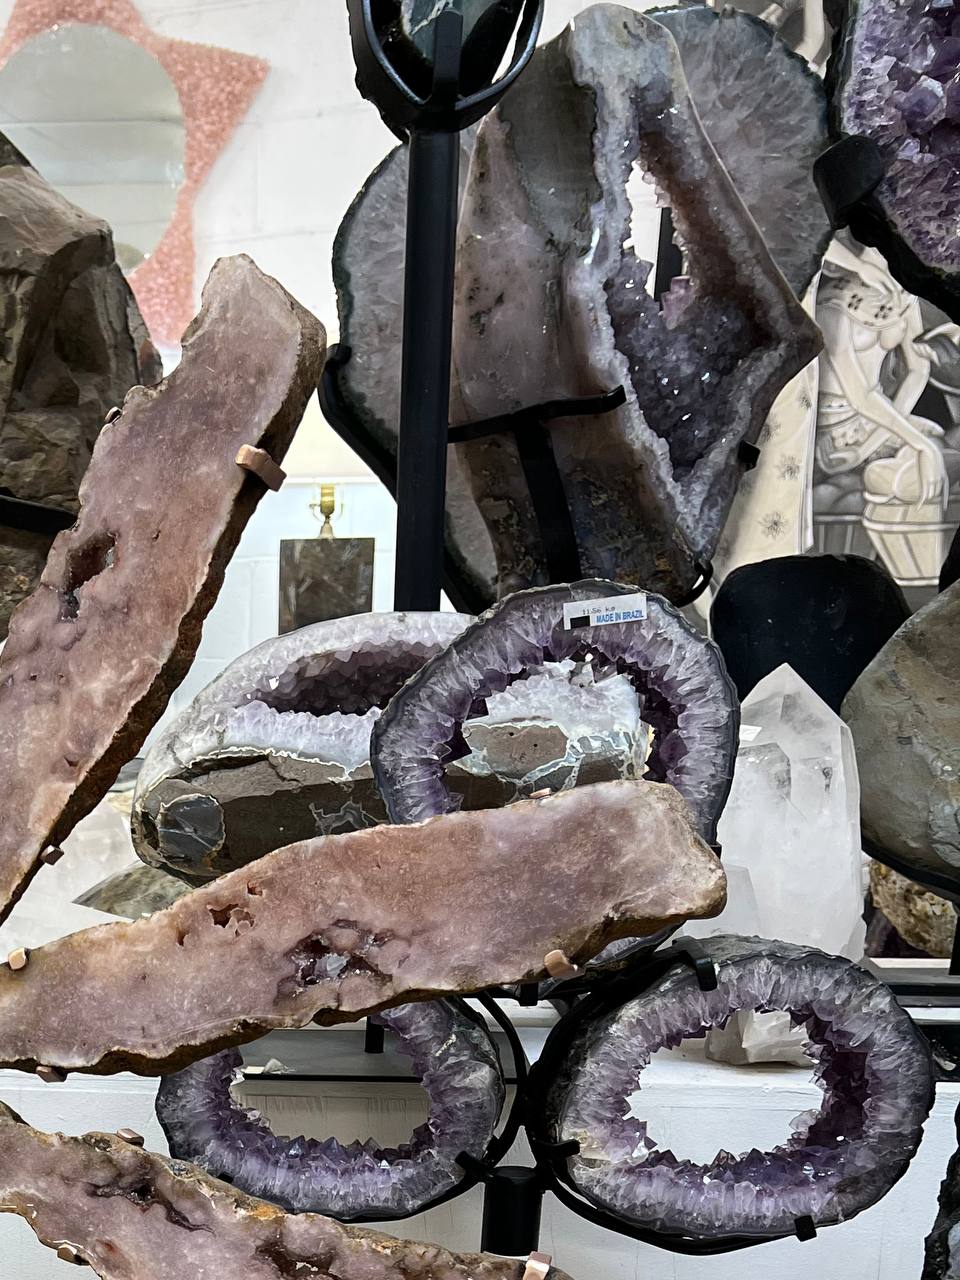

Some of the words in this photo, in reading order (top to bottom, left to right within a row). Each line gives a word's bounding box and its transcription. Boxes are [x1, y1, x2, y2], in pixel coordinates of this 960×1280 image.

[596, 613, 614, 623] MADE
[614, 612, 622, 621] IN
[622, 610, 644, 620] BRAZIL
